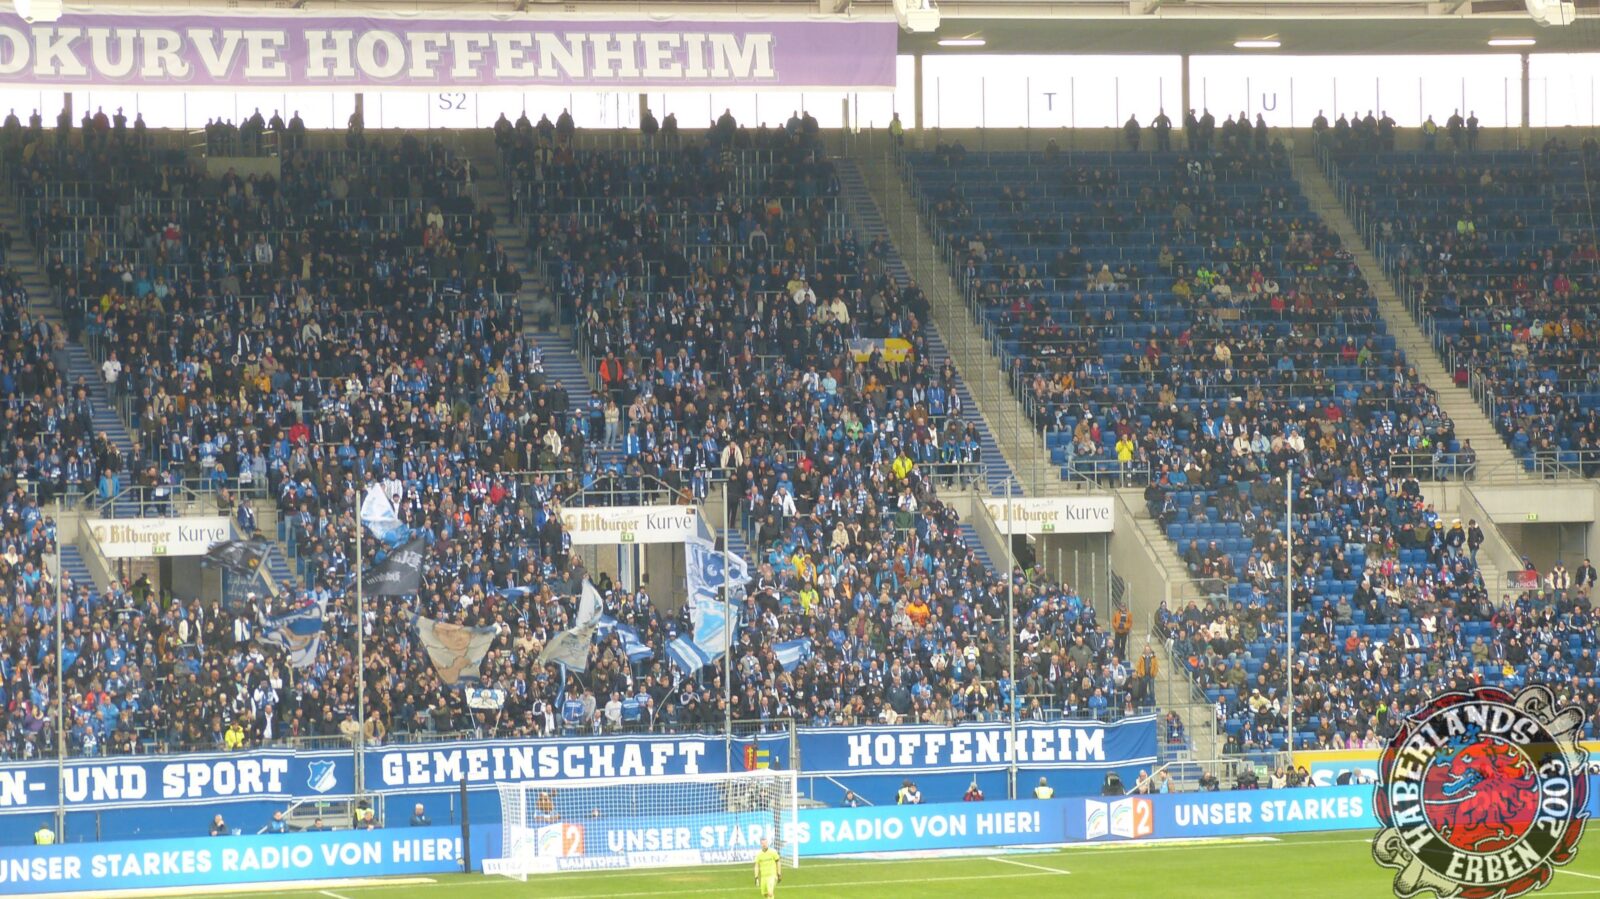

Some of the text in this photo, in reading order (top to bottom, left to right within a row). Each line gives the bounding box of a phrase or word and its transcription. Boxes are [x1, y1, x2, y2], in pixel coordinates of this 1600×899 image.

[304, 29, 777, 80] HOFFENHEIM
[439, 92, 467, 111] S2
[1043, 92, 1057, 111] T
[1262, 92, 1277, 111] U
[580, 512, 640, 533] Bitburger
[646, 513, 692, 530] Kurve
[1066, 504, 1109, 520] Kurve
[109, 524, 171, 545] Bitburger
[178, 525, 224, 542] Kurve
[848, 728, 1106, 766] HOFFENHEIM
[382, 741, 706, 785] GEMEINSCHAFT
[62, 765, 147, 802] UND
[163, 759, 288, 799] SPORT
[1175, 800, 1253, 826] UNSER
[1260, 797, 1364, 822] STARKES
[607, 828, 690, 852] UNSER
[820, 817, 902, 842] RADIO
[912, 815, 966, 837] VON
[976, 811, 1041, 835] HIER!
[91, 848, 212, 878] STARKES
[222, 845, 313, 871] RADIO
[321, 841, 382, 865] VON
[392, 837, 461, 863] HIER!
